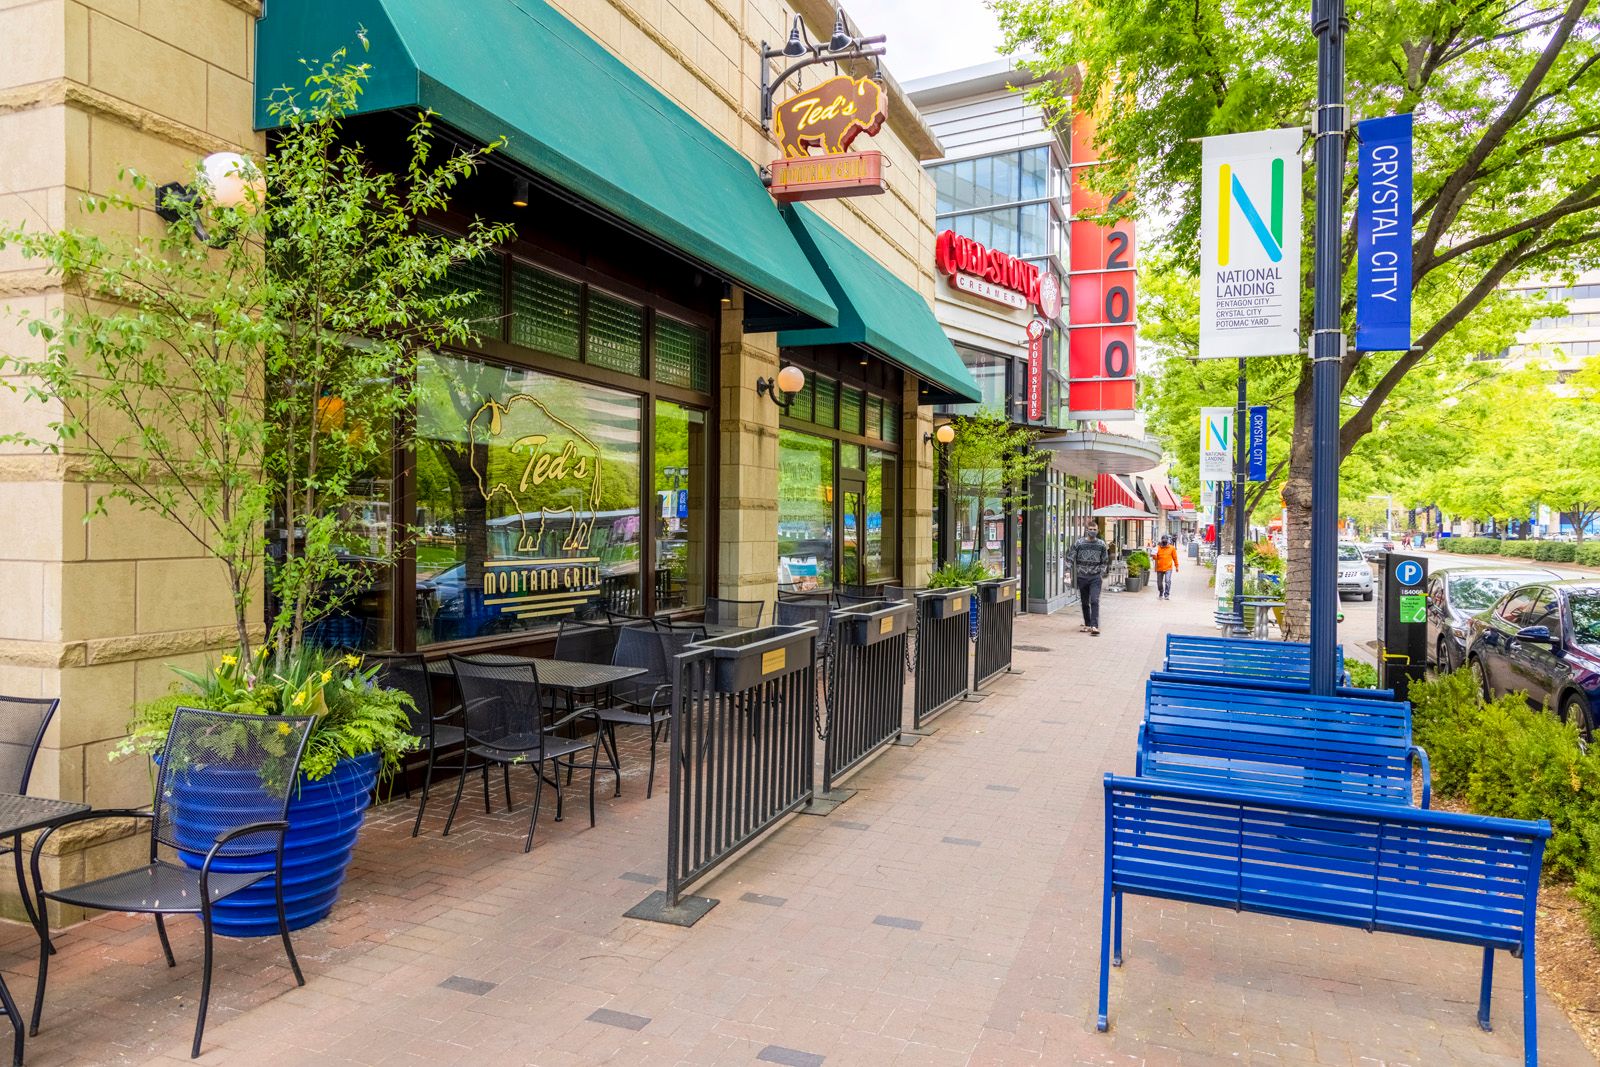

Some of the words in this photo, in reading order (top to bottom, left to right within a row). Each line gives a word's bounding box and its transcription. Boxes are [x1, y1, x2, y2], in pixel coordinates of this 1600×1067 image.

[791, 95, 857, 130] Ted's
[1371, 145, 1399, 245] CRYSTAL
[937, 229, 988, 277] COLD
[986, 248, 1039, 305] STONE
[1217, 267, 1282, 284] NATIONAL
[1371, 251, 1398, 302] CITY
[959, 277, 1024, 305] CREAMERY
[1216, 282, 1275, 298] LANDING
[1216, 299, 1253, 308] PENTAGON
[1254, 298, 1270, 306] CITY
[1216, 310, 1245, 318] CRYSTAL
[1246, 308, 1262, 316] CITY
[1216, 320, 1249, 328] POTOMAC
[1250, 318, 1269, 326] YARD
[1031, 342, 1039, 375] COLD
[1031, 377, 1039, 417] STONE
[1253, 414, 1264, 448] CRYSTAL
[511, 434, 589, 493] Ted's
[1253, 449, 1263, 466] CITY
[484, 569, 558, 595] MONTANA
[564, 566, 601, 588] GRILL
[1405, 565, 1417, 581] P
